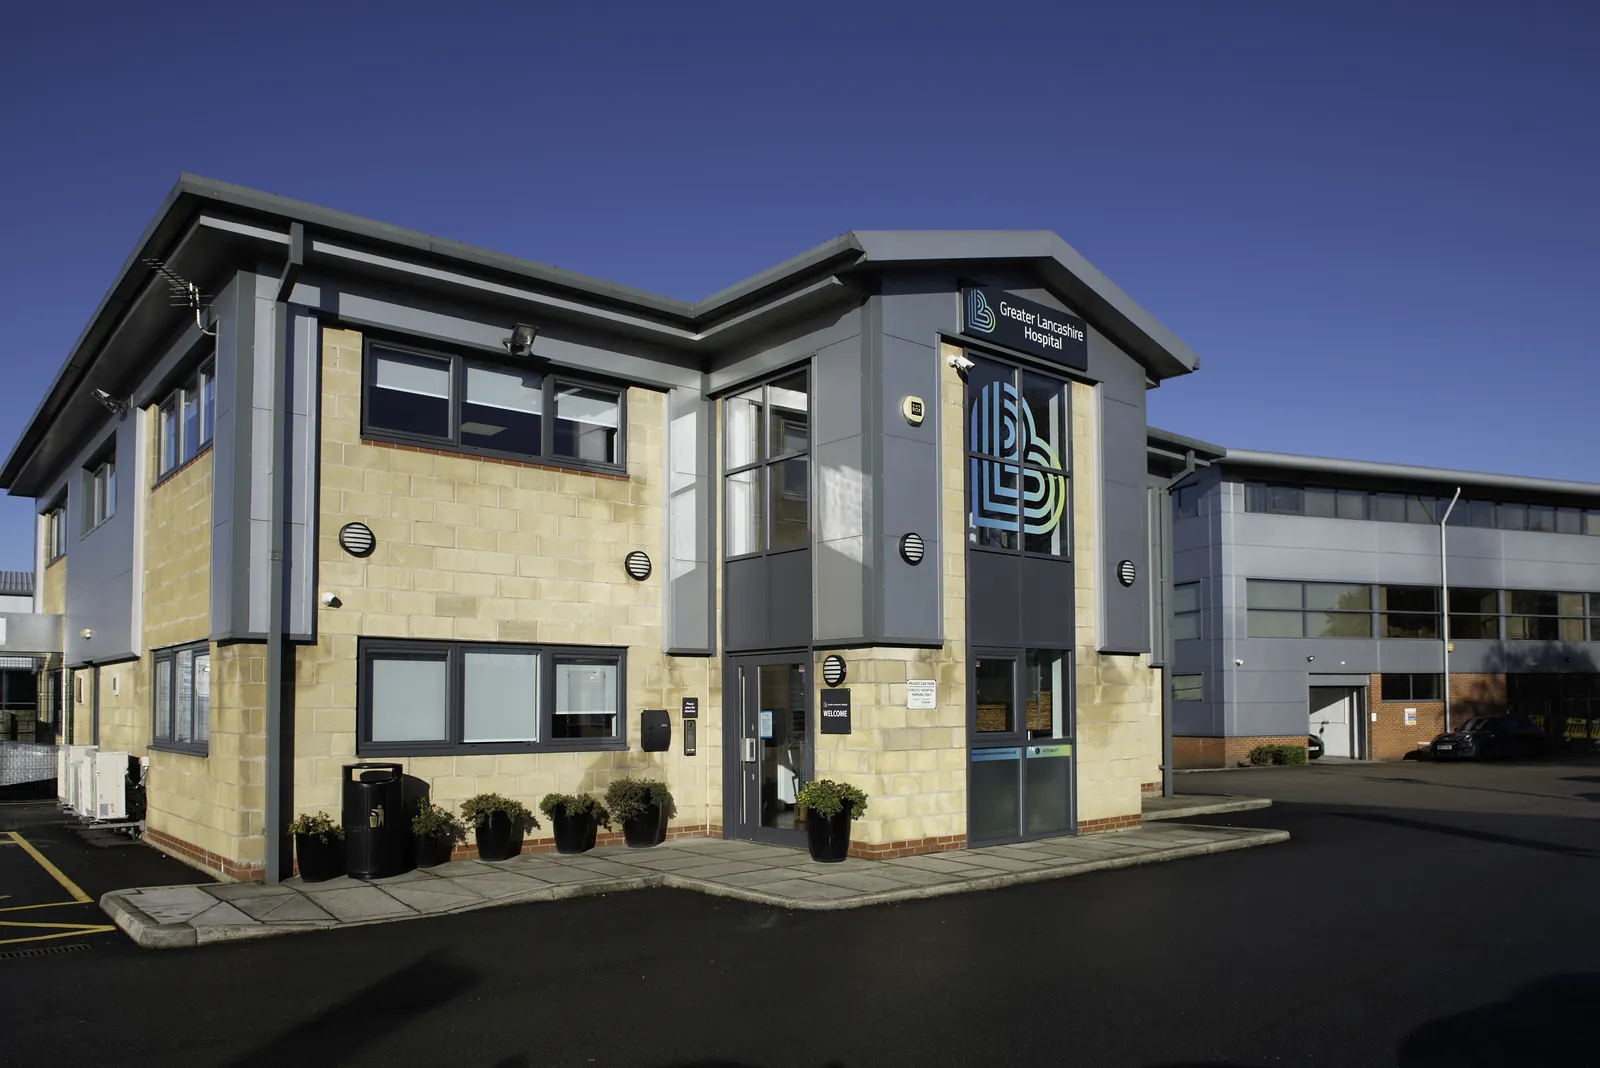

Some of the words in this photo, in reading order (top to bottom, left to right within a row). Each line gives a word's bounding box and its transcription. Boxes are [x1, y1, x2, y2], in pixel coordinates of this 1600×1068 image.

[1000, 301, 1036, 325] Greater
[1037, 313, 1084, 341] Lancashire
[1024, 326, 1063, 350] Hospital
